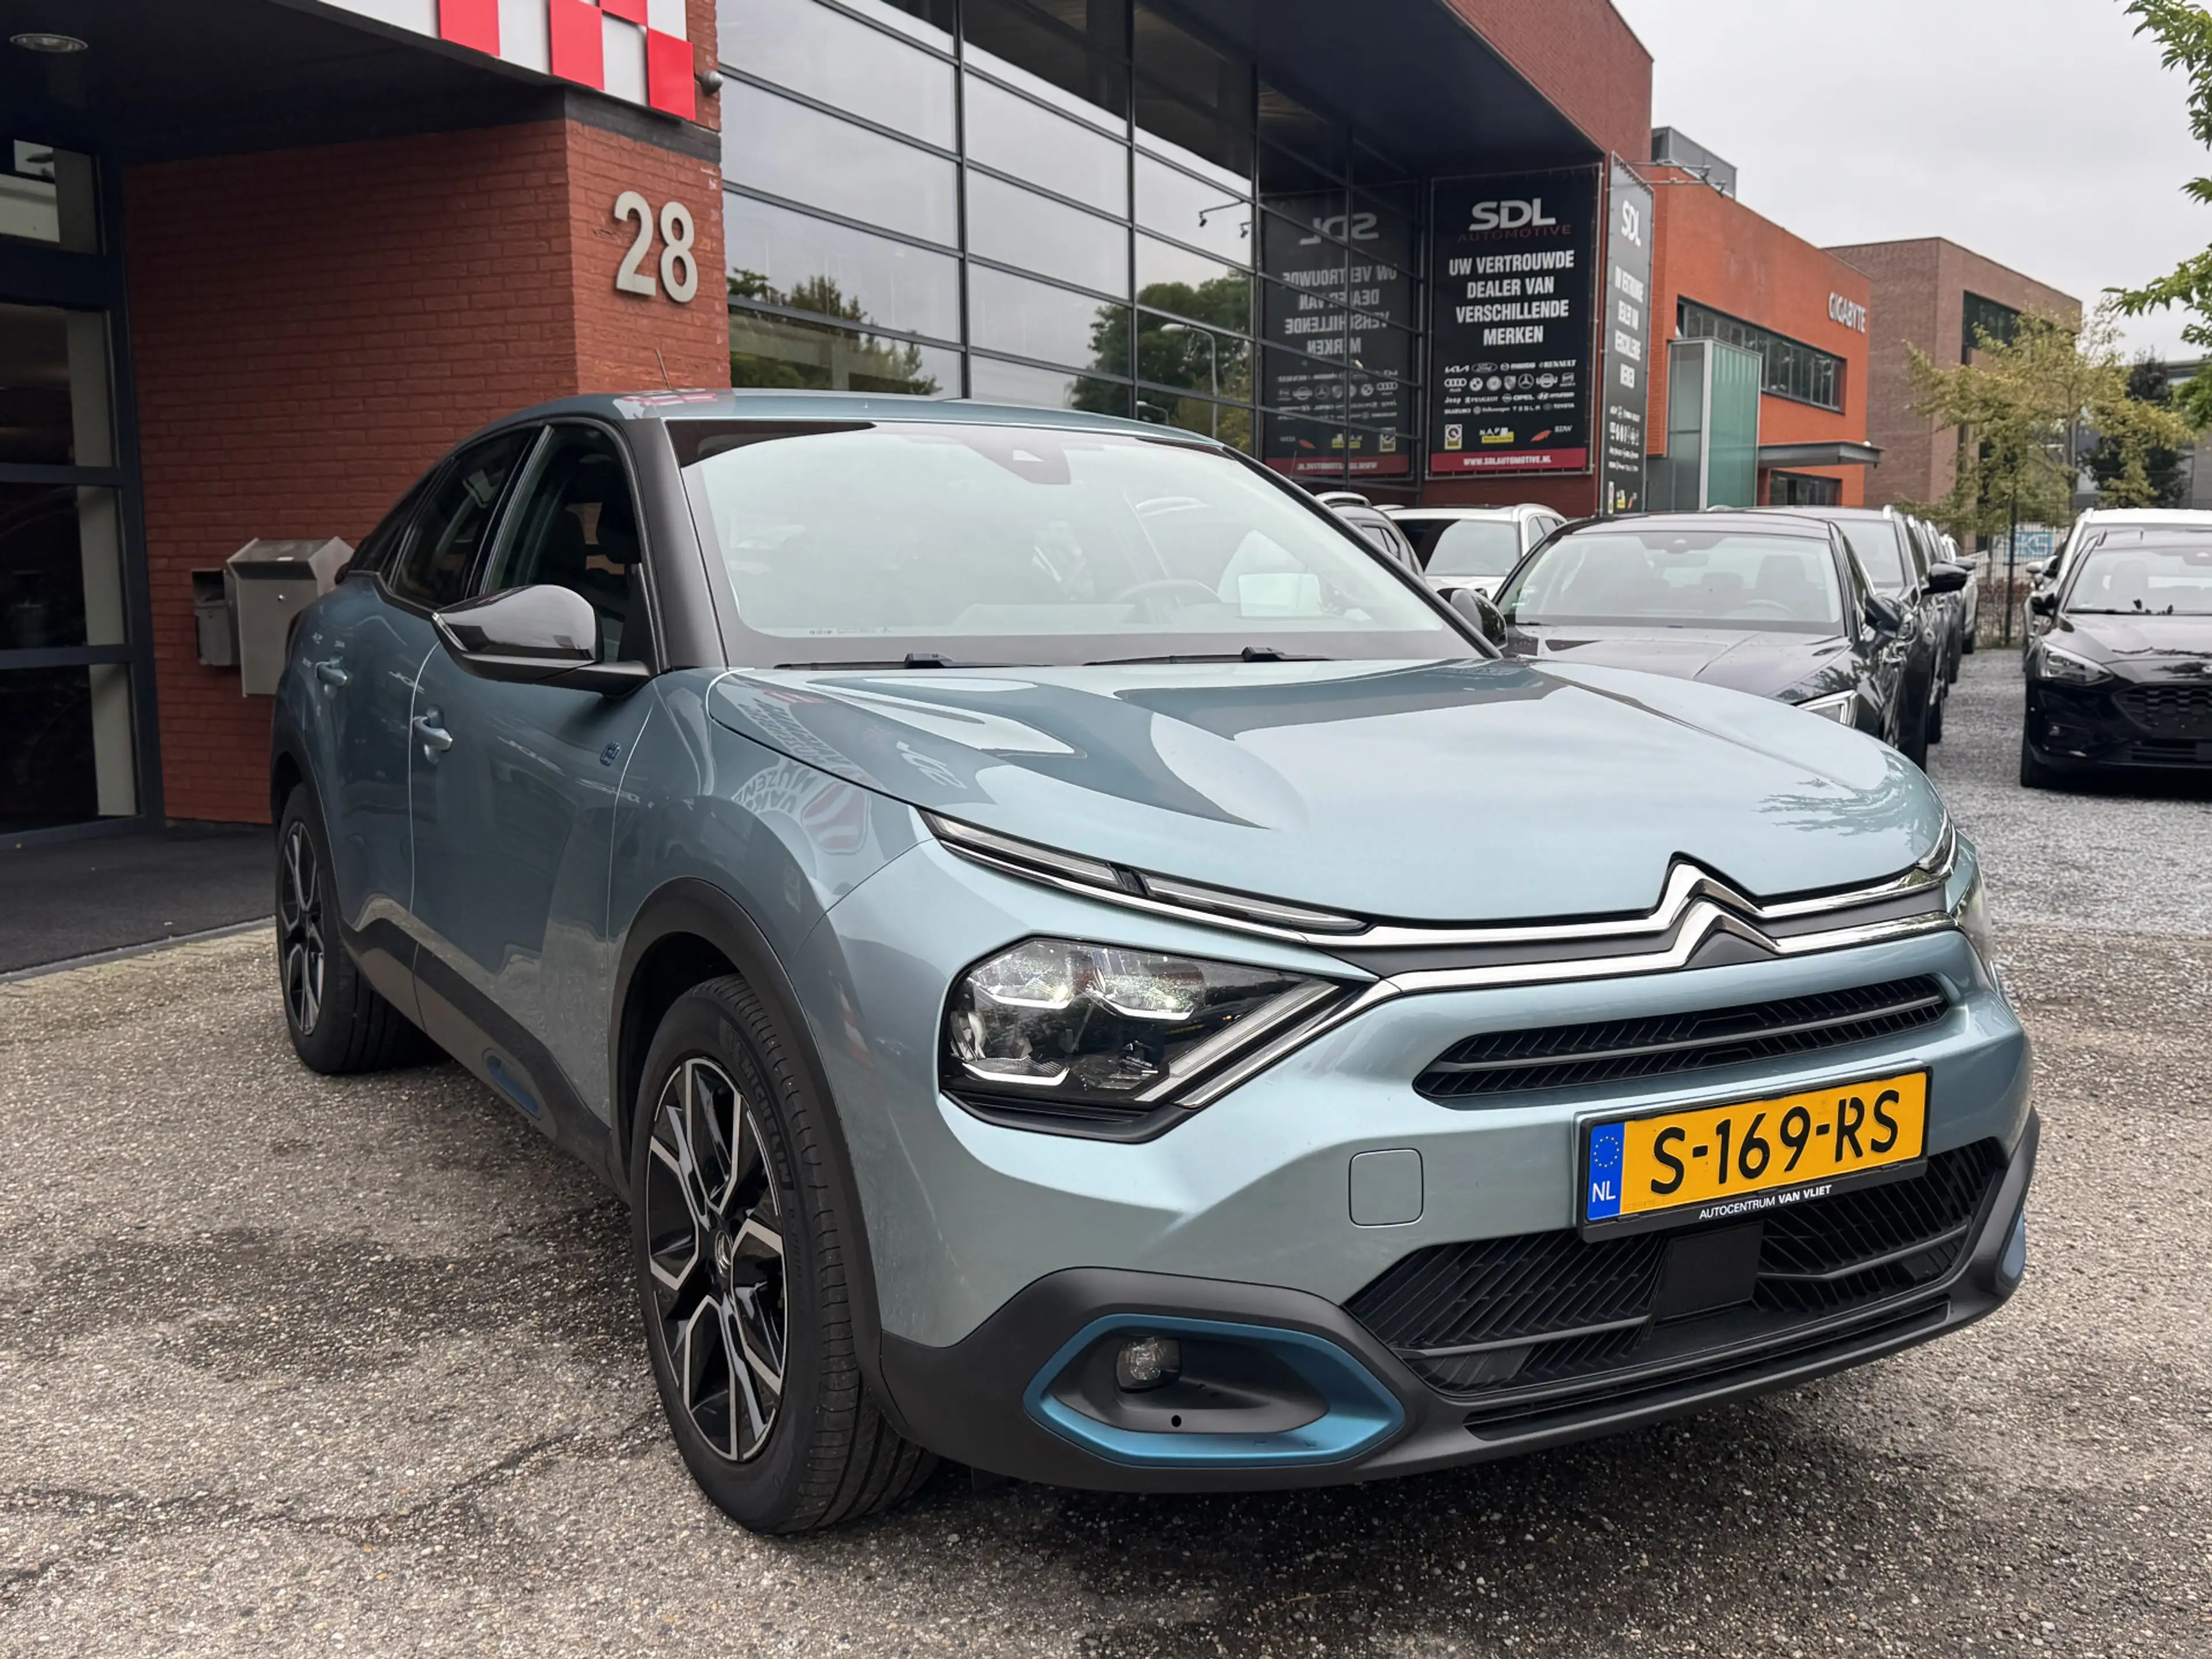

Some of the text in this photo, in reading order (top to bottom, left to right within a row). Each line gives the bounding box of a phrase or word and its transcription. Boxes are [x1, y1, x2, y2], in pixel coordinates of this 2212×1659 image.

[1469, 198, 1556, 231] SDL
[1621, 200, 1641, 247] SDL
[614, 191, 698, 303] 28
[1458, 224, 1573, 244] AUTOMOTIVE
[1449, 250, 1575, 276] UW VERTROUWDE
[1467, 276, 1555, 299] DEALER VAN
[1456, 299, 1570, 324] VERSCHILLENDE
[1483, 325, 1544, 346] MERKEN
[1650, 1089, 1900, 1195] S-169-RS
[1592, 1181, 1616, 1203] NL
[1699, 1184, 1832, 1220] AUTOCENTRUM VAN VLIET
